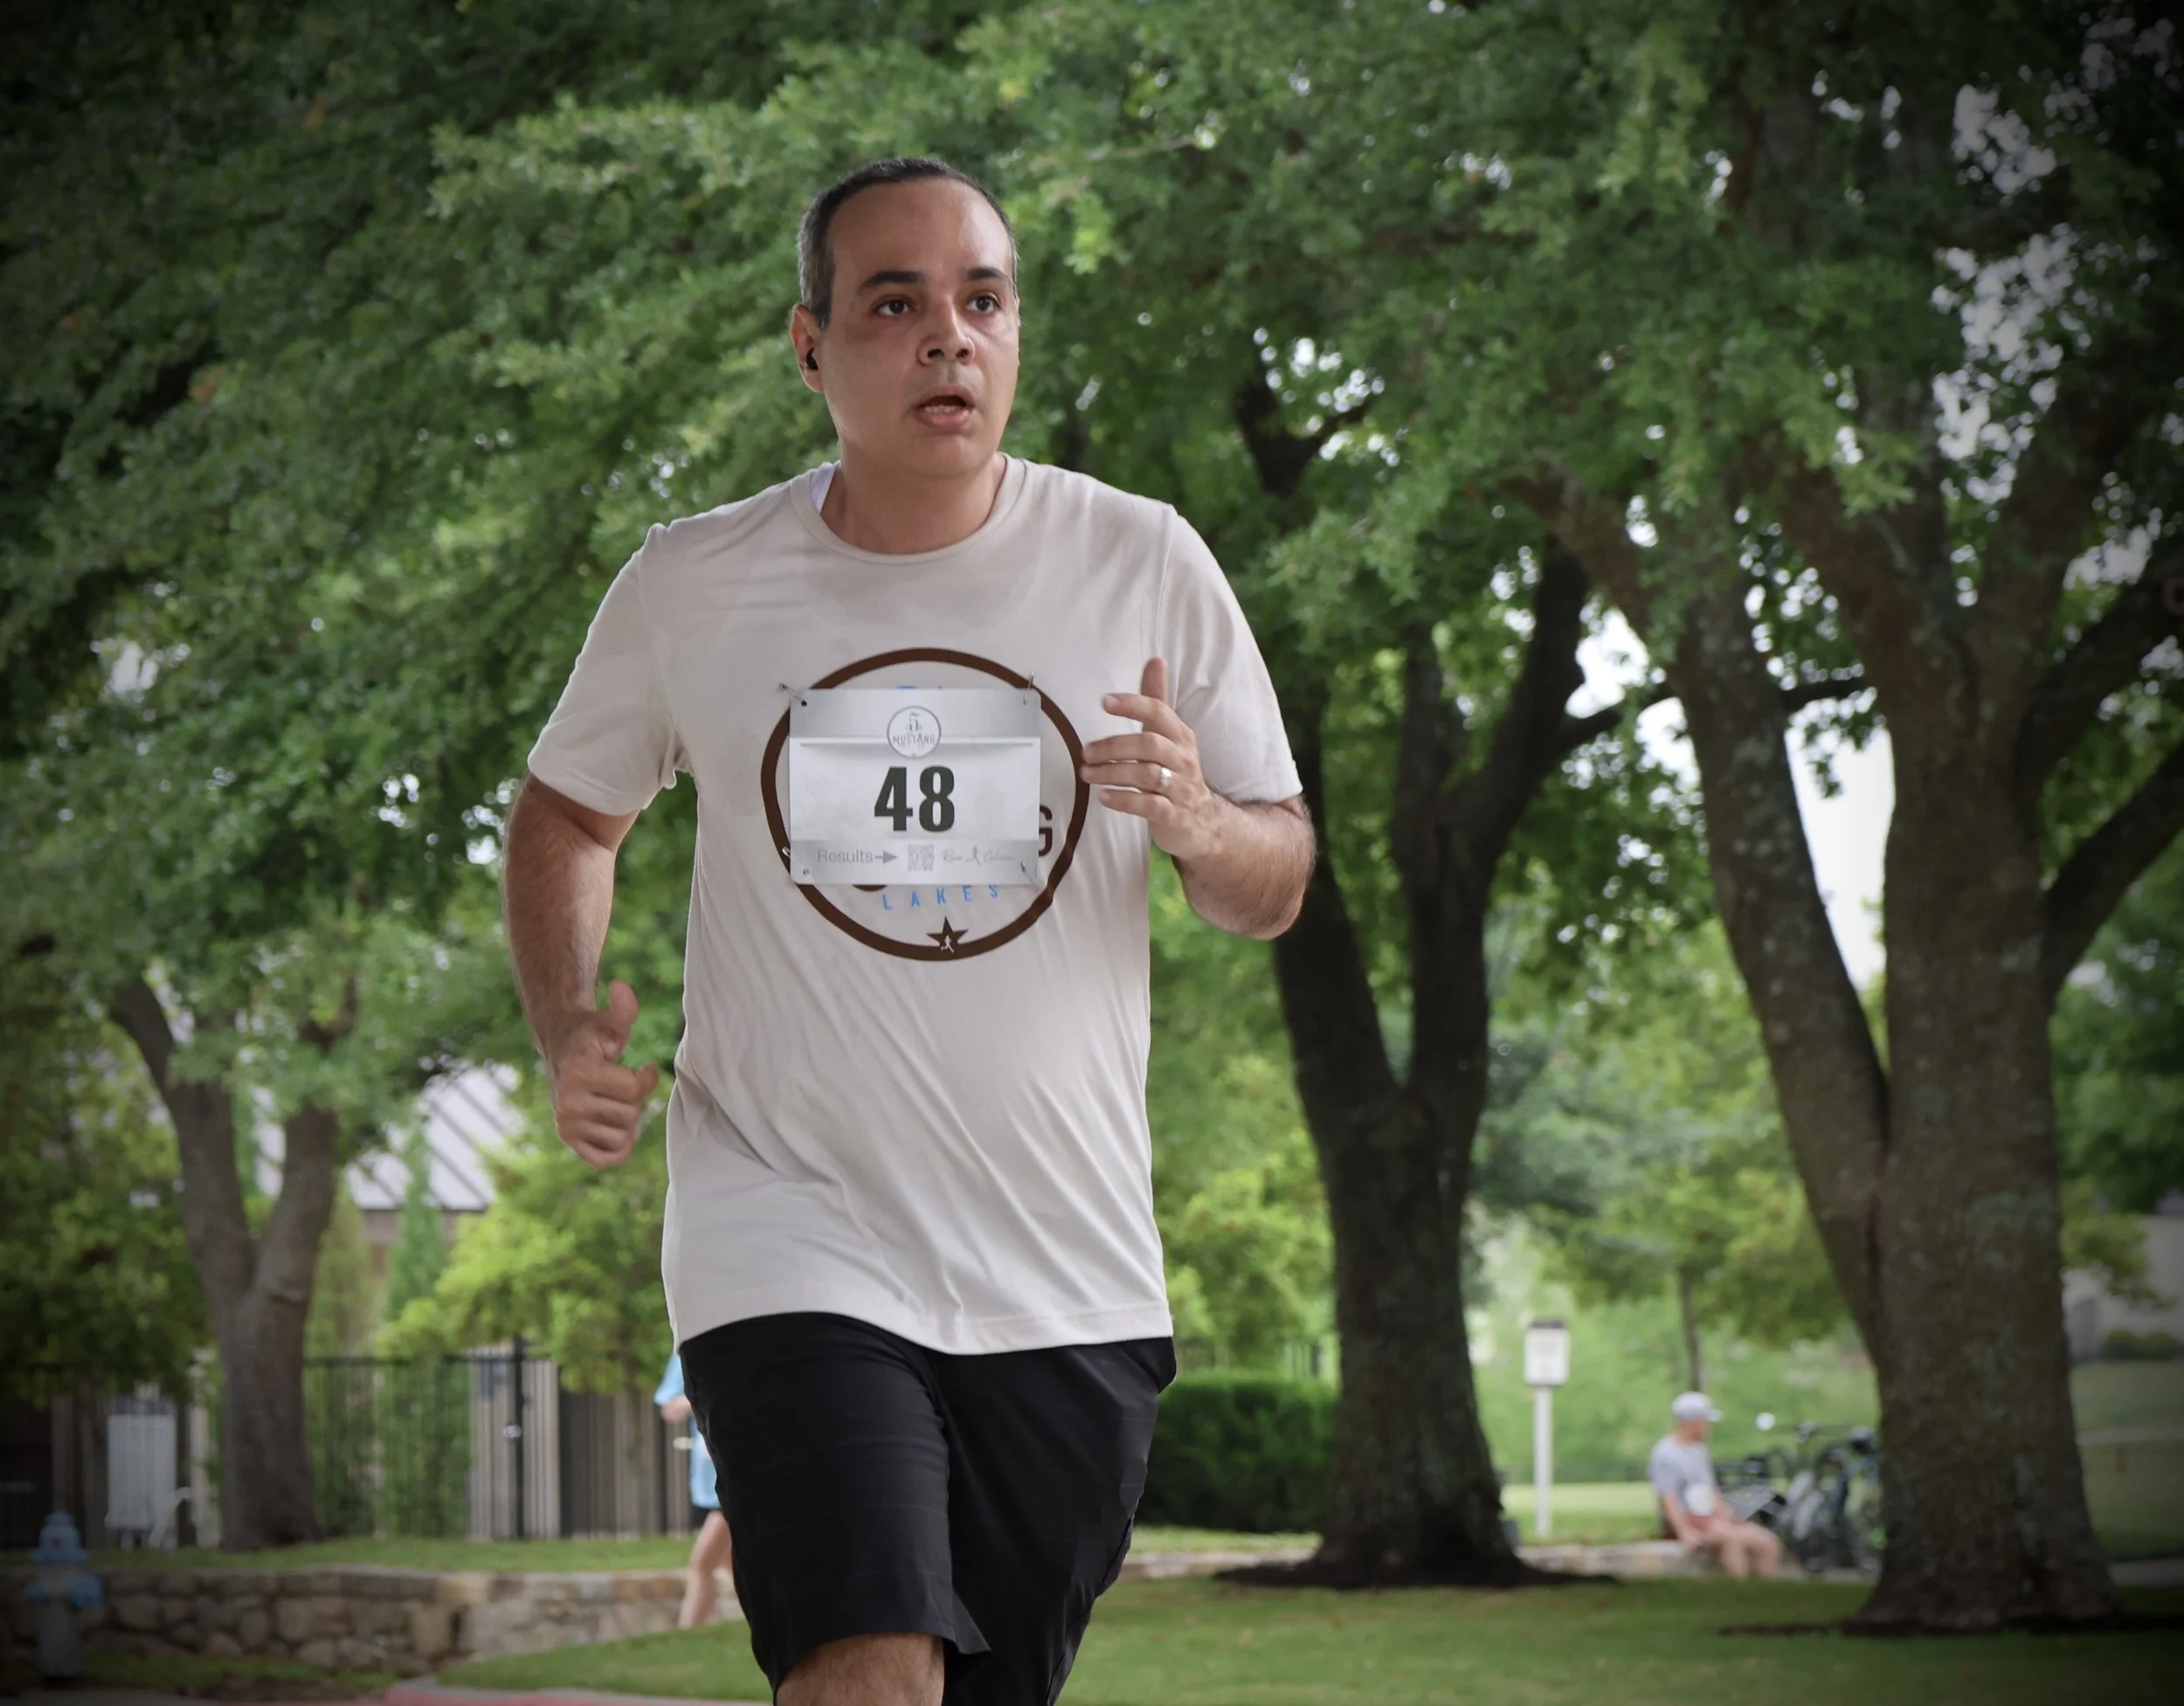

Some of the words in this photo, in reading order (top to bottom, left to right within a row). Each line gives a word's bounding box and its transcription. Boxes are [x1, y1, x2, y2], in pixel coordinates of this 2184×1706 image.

[874, 765, 955, 832] 48
[817, 848, 874, 864] Results
[881, 884, 998, 911] LAKES
